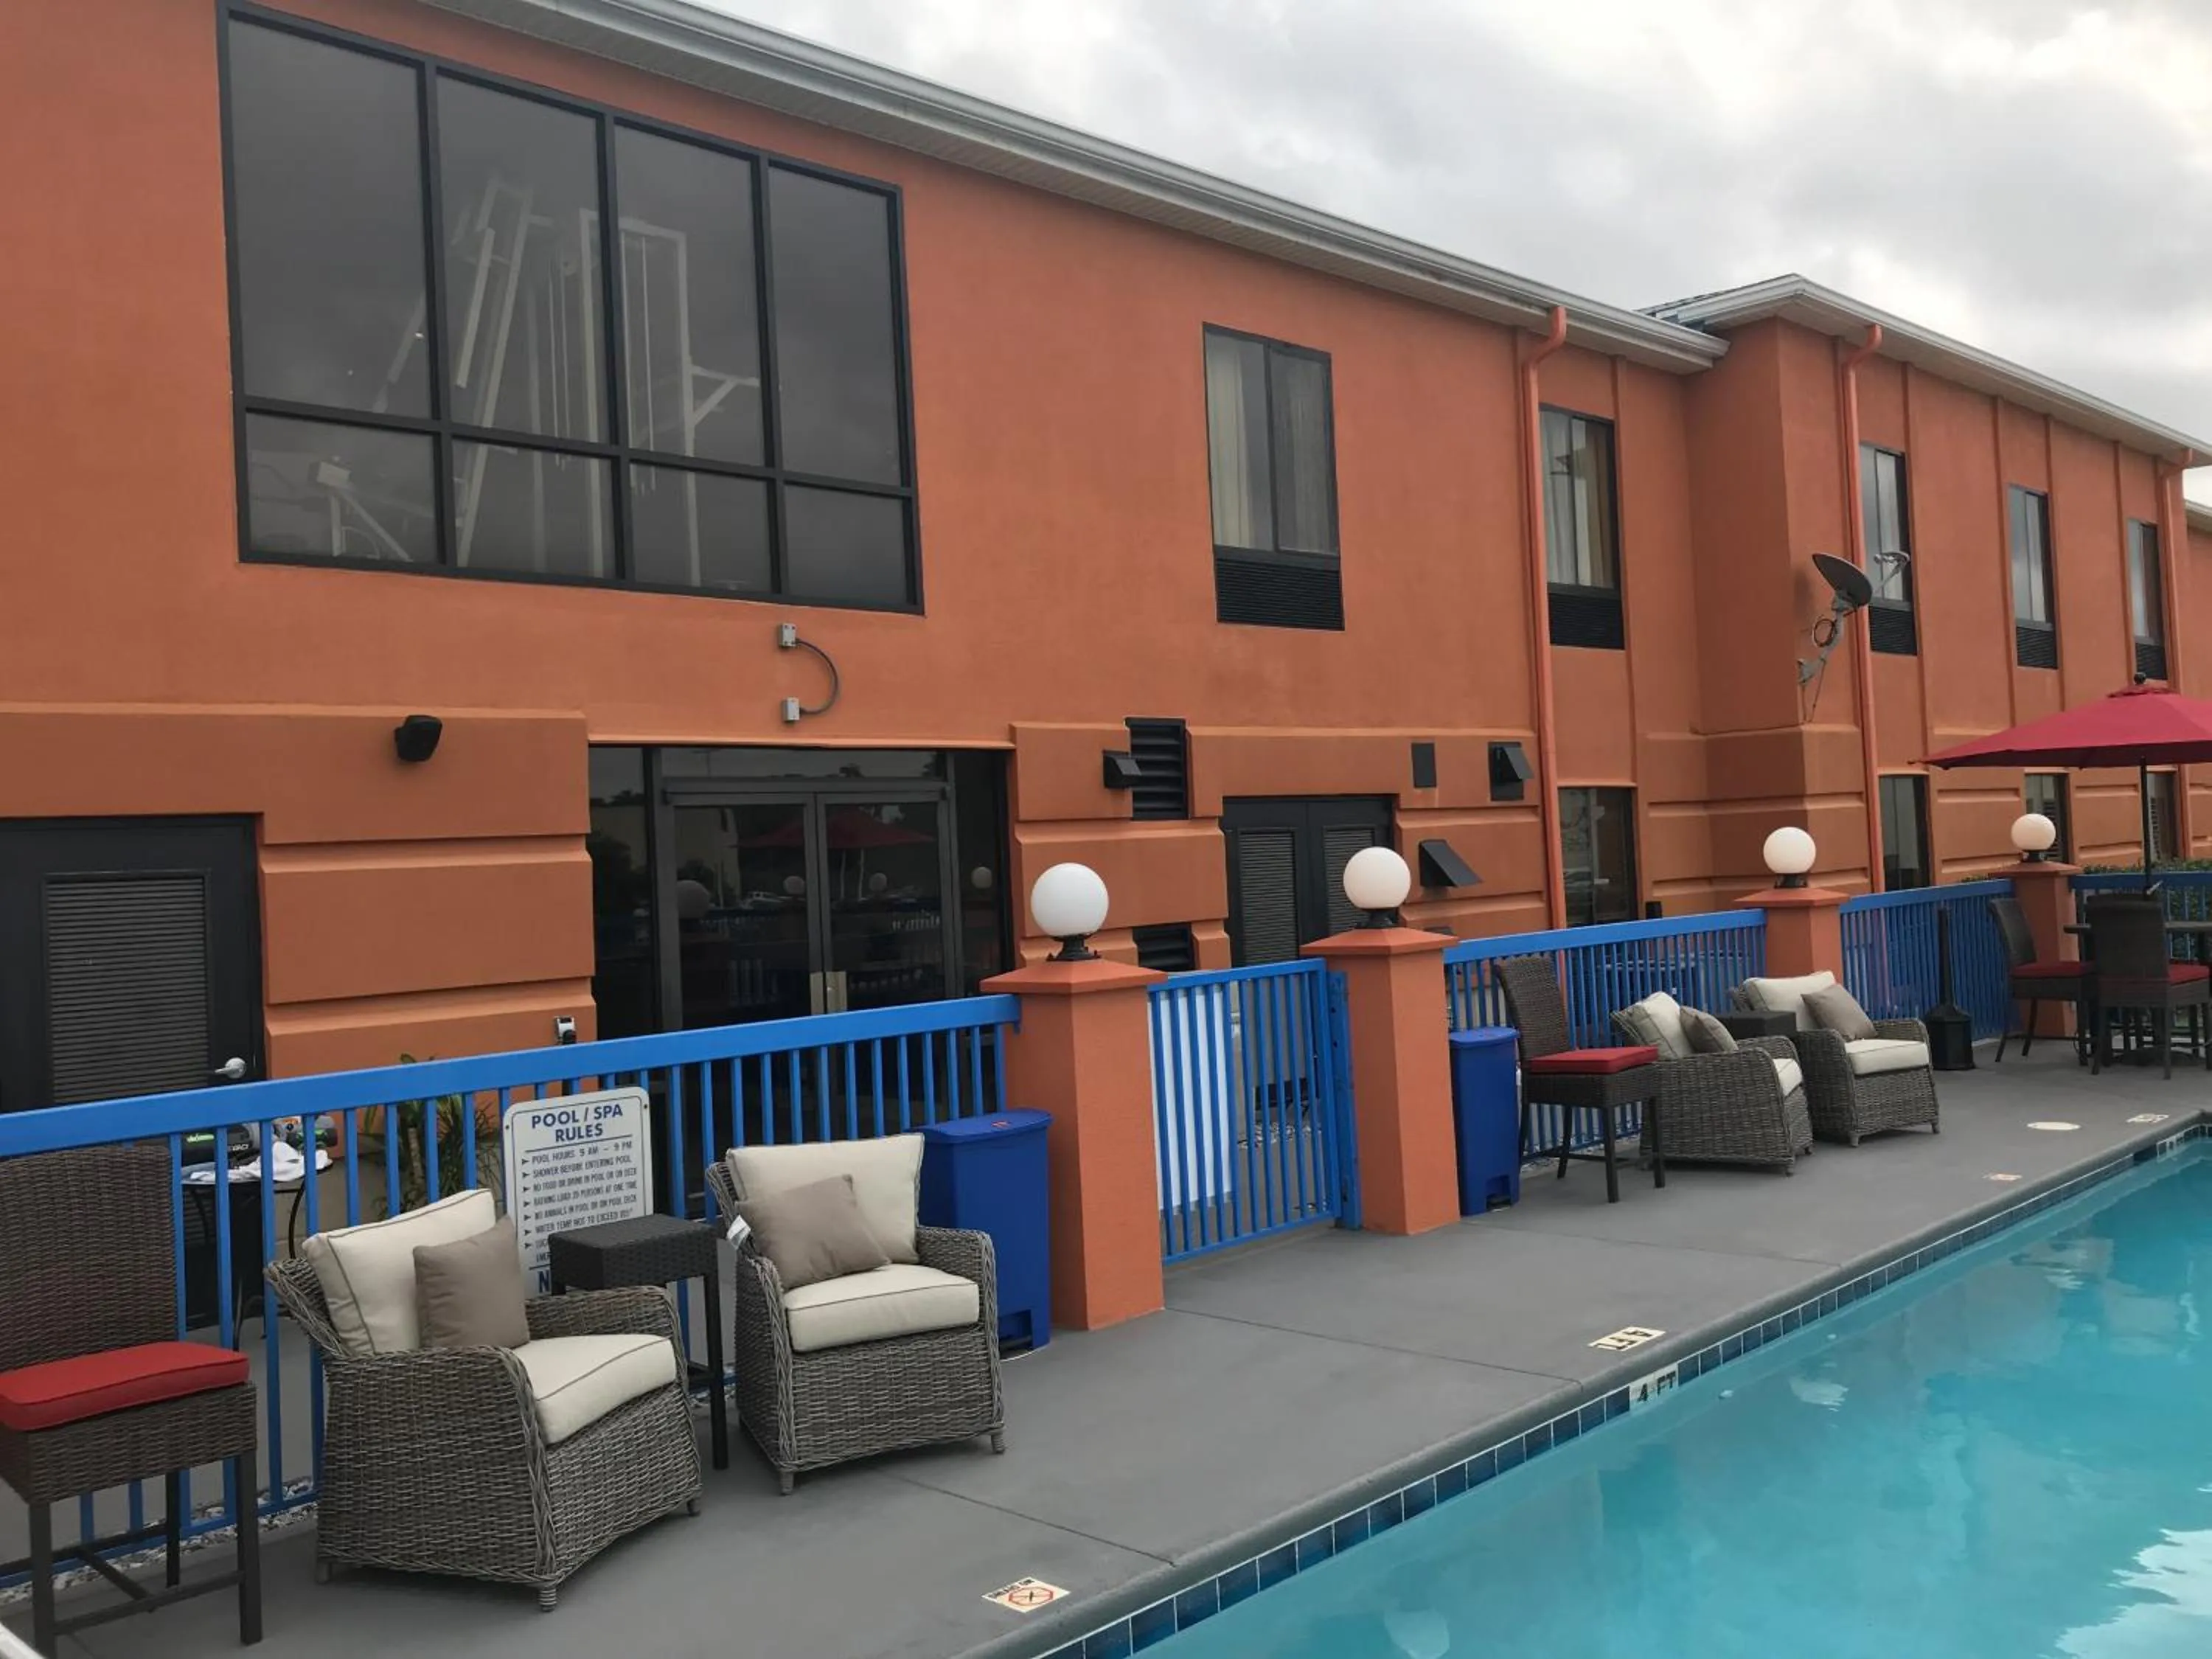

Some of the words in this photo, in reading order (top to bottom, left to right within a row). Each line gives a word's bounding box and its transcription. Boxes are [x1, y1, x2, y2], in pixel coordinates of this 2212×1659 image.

[532, 1110, 580, 1129] POOL
[594, 1104, 623, 1120] SPA
[555, 1123, 603, 1142] RULES
[532, 1154, 549, 1164] POOL
[552, 1150, 575, 1161] HOURS
[532, 1167, 559, 1178] SHOWER
[538, 1269, 550, 1294] N
